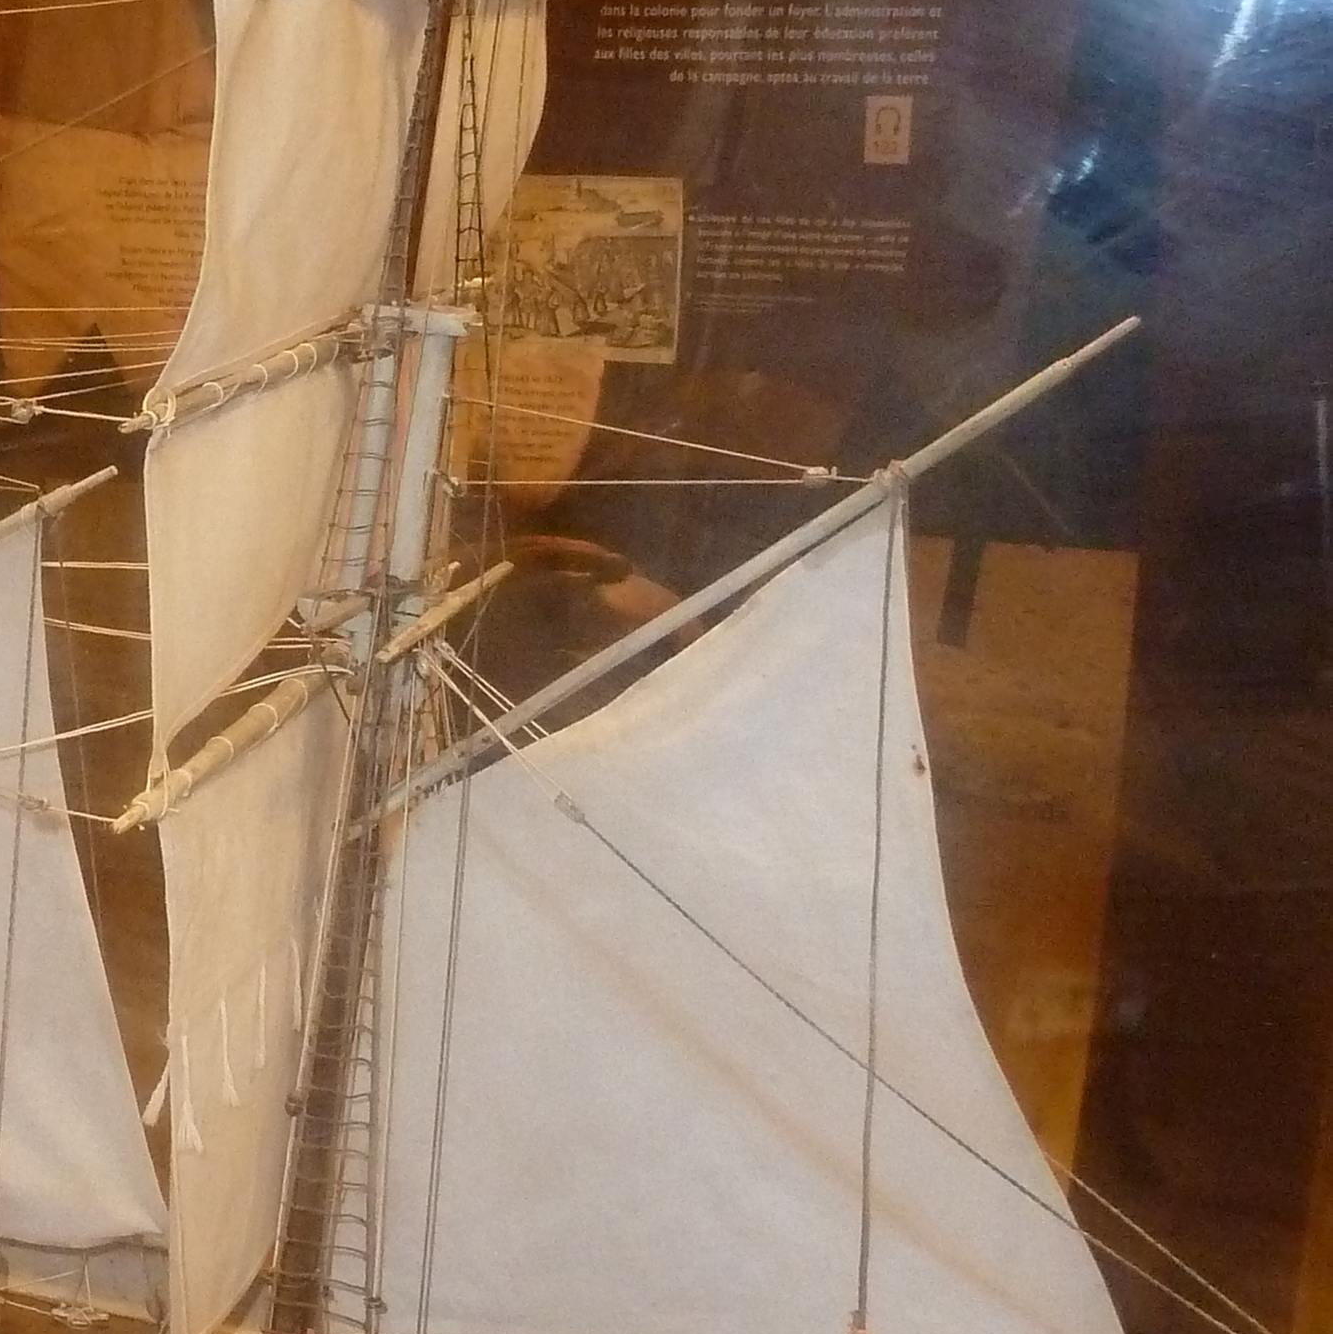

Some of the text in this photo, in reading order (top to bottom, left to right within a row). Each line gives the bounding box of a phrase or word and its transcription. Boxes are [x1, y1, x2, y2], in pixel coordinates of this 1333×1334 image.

[600, 4, 625, 17] dans
[629, 3, 641, 17] la
[643, 4, 688, 17] colonie
[691, 6, 720, 20] pour
[723, 3, 765, 17] fonder
[597, 25, 614, 38] les
[617, 25, 678, 42] religieuses
[764, 26, 780, 39] de
[617, 47, 646, 61] filles
[668, 69, 685, 83] de
